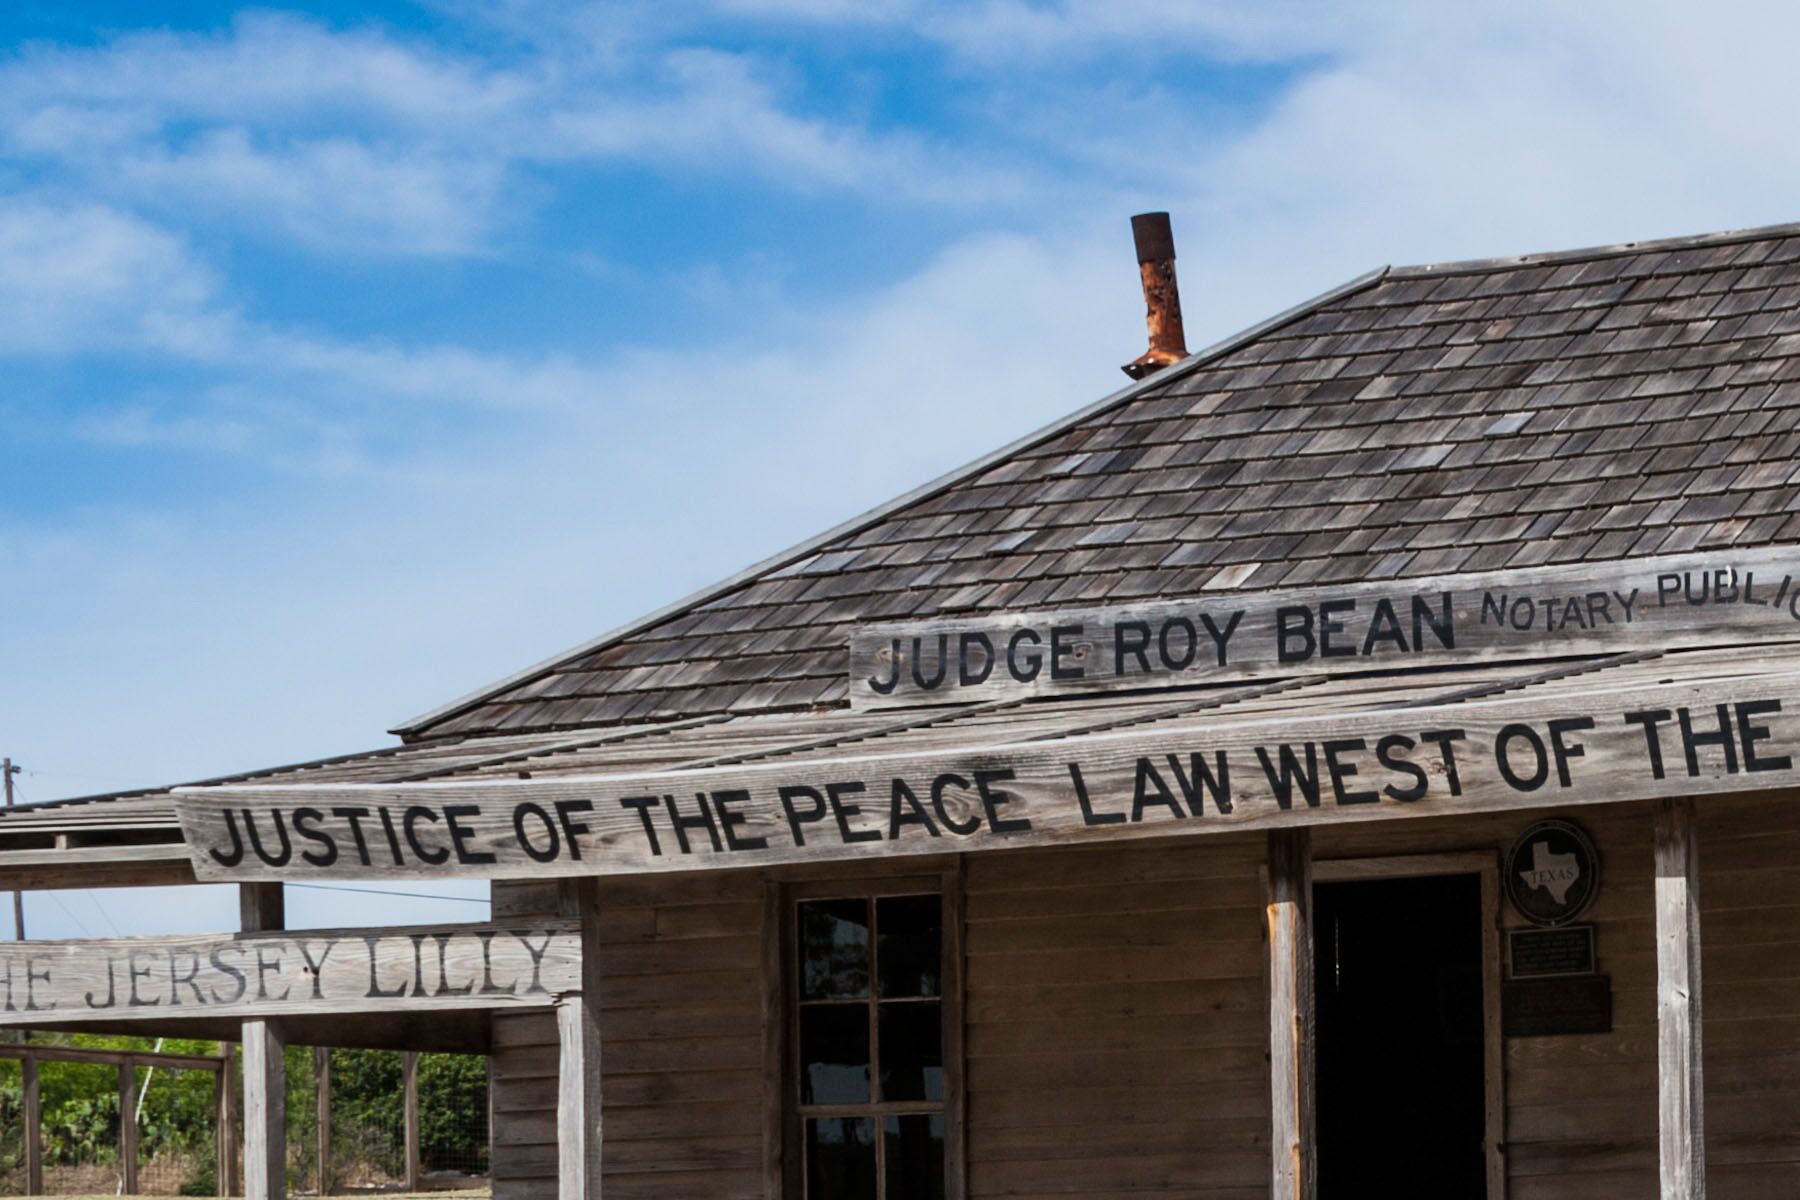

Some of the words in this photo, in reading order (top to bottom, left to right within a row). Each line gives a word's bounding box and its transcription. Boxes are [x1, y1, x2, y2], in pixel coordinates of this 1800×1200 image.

[869, 625, 1085, 694] JUDGE
[1114, 610, 1246, 676] ROY
[1276, 591, 1456, 664] BEAN
[1480, 588, 1641, 632] NOTARY
[210, 806, 497, 867] JUSTICE
[513, 799, 594, 863] OF
[620, 790, 767, 856] THE
[778, 769, 1032, 847] PEACE
[1068, 750, 1234, 827] LAW
[1255, 728, 1467, 811] WEST
[1495, 716, 1595, 792] OF
[1625, 699, 1793, 780] THE
[1530, 866, 1575, 884] TEXAS
[84, 938, 339, 1009] JERSEY
[363, 929, 559, 998] LILLY
